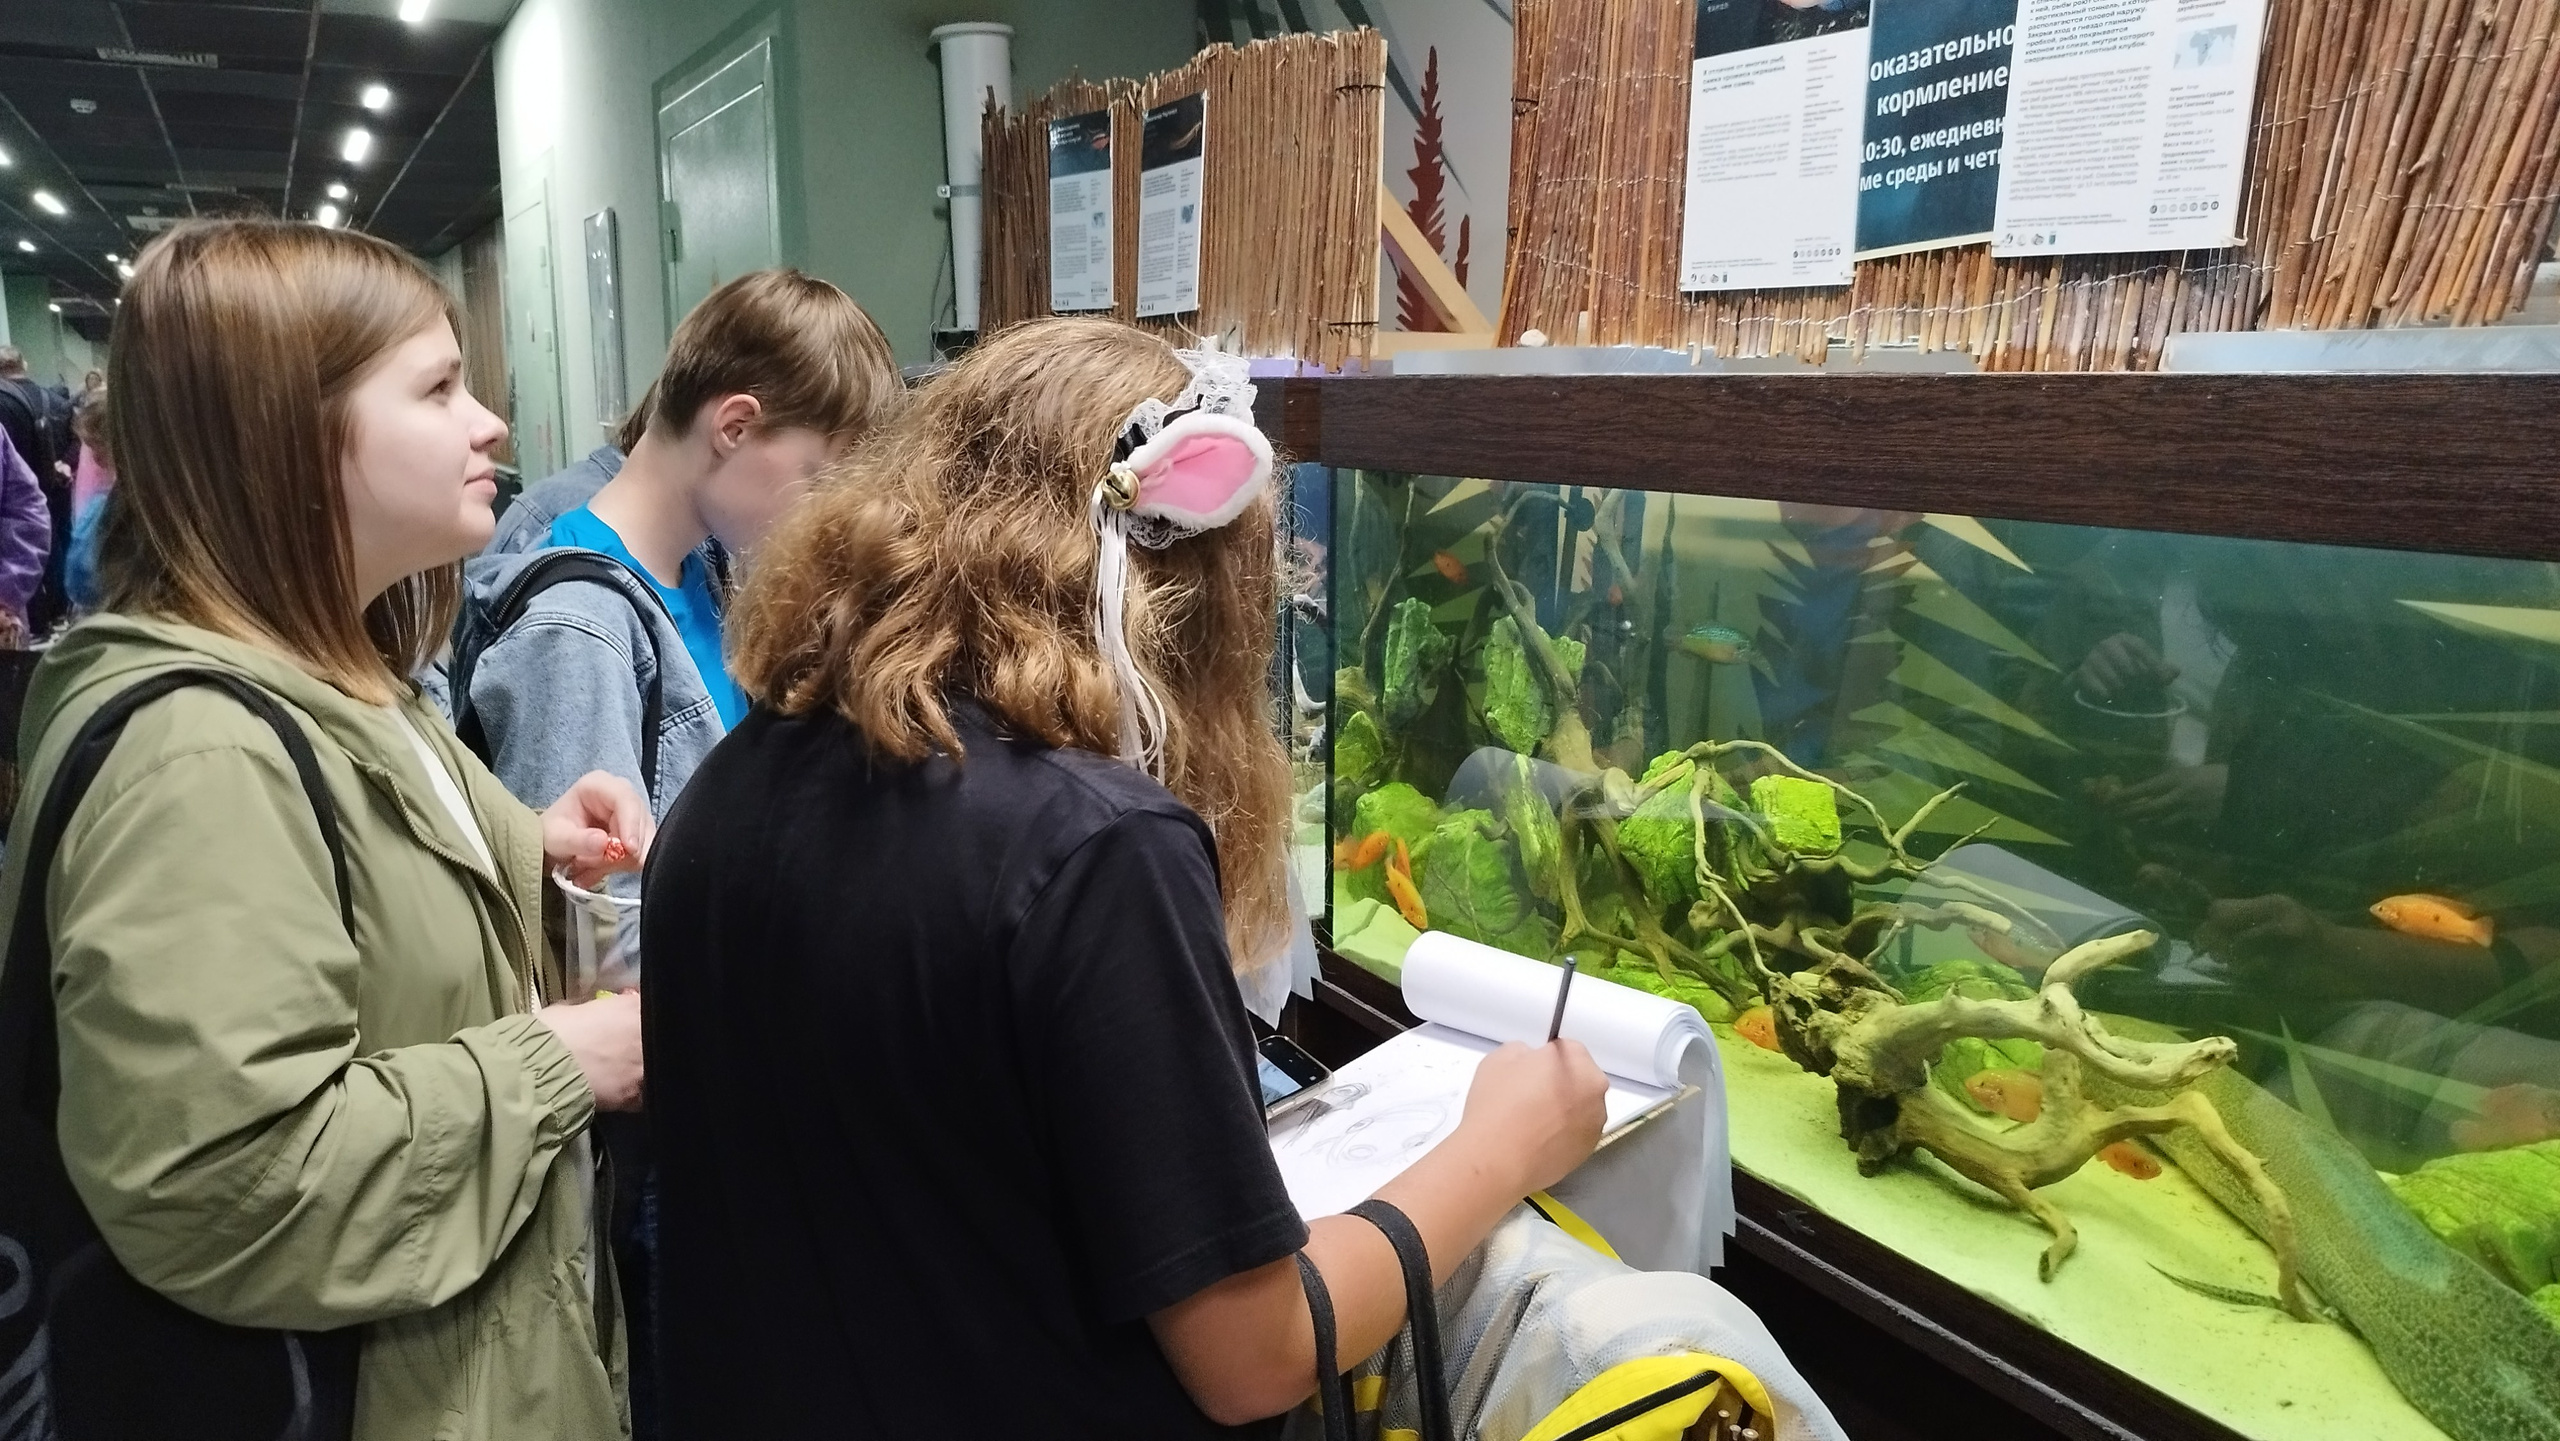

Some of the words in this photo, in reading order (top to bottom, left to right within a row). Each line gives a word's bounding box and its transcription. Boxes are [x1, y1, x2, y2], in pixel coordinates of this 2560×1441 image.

[2028, 17, 2083, 31] располагаются
[2085, 11, 2115, 21] головой
[2035, 8, 2086, 21] вертикальный
[2085, 45, 2116, 54] плотный
[2120, 31, 2155, 42] которого
[1870, 25, 2015, 81] оказательно
[1877, 66, 2008, 116] кормление
[1910, 117, 2005, 152] ежедневн
[1860, 173, 1882, 192] ме
[1886, 160, 1943, 189] среды
[1947, 155, 1959, 174] и
[1964, 149, 2001, 169] чет
